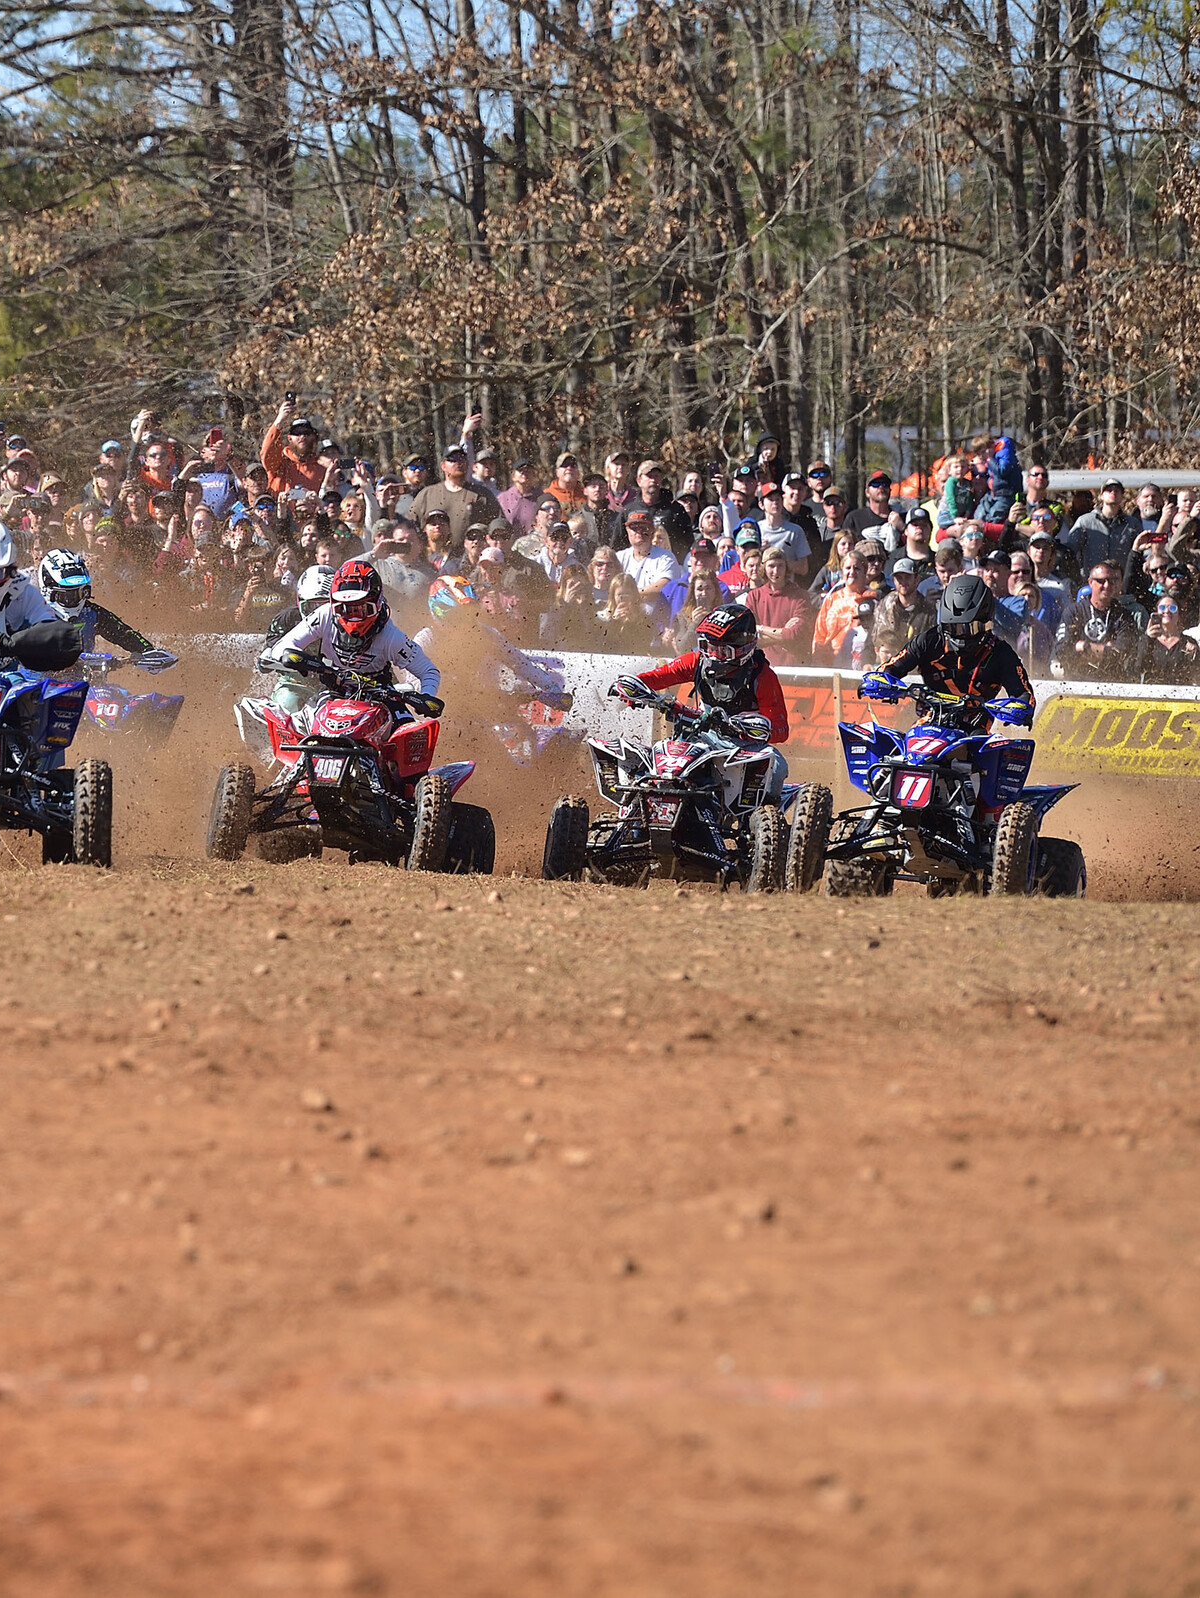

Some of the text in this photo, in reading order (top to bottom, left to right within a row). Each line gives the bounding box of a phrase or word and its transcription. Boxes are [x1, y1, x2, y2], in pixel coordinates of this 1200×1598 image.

[95, 702, 119, 716] 10
[908, 738, 944, 754] 11
[314, 758, 345, 782] 406
[897, 775, 929, 801] 11
